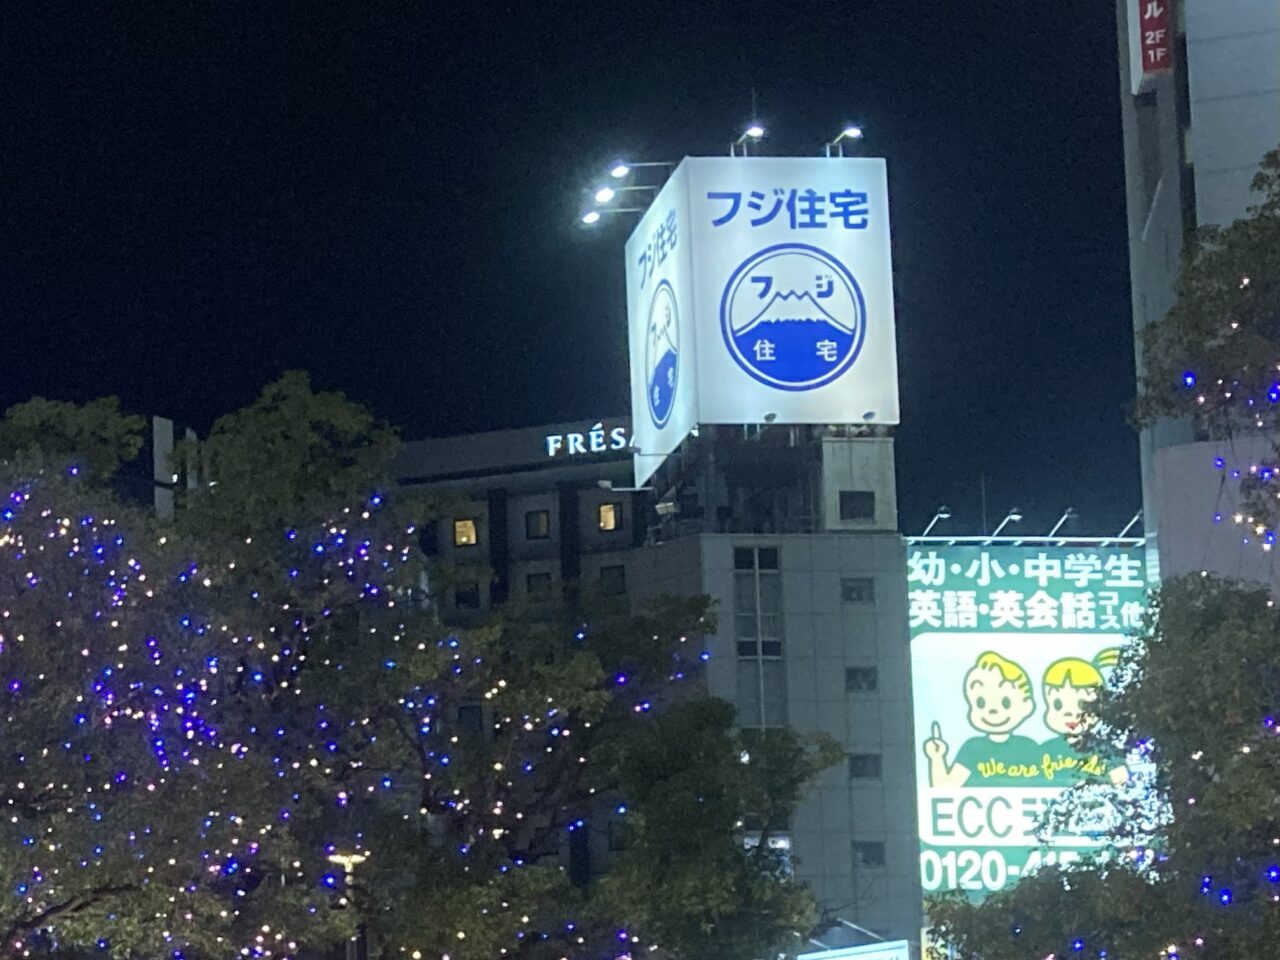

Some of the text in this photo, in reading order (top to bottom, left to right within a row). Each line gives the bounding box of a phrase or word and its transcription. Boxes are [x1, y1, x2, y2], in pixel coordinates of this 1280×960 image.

[1145, 29, 1167, 45] 2F
[1148, 48, 1168, 63] 1F
[707, 188, 869, 230] フジ住宅
[546, 422, 635, 457] FRÉS
[907, 551, 1145, 588] 幼・小・中学生
[978, 758, 1006, 777] We
[1008, 764, 1039, 777] are
